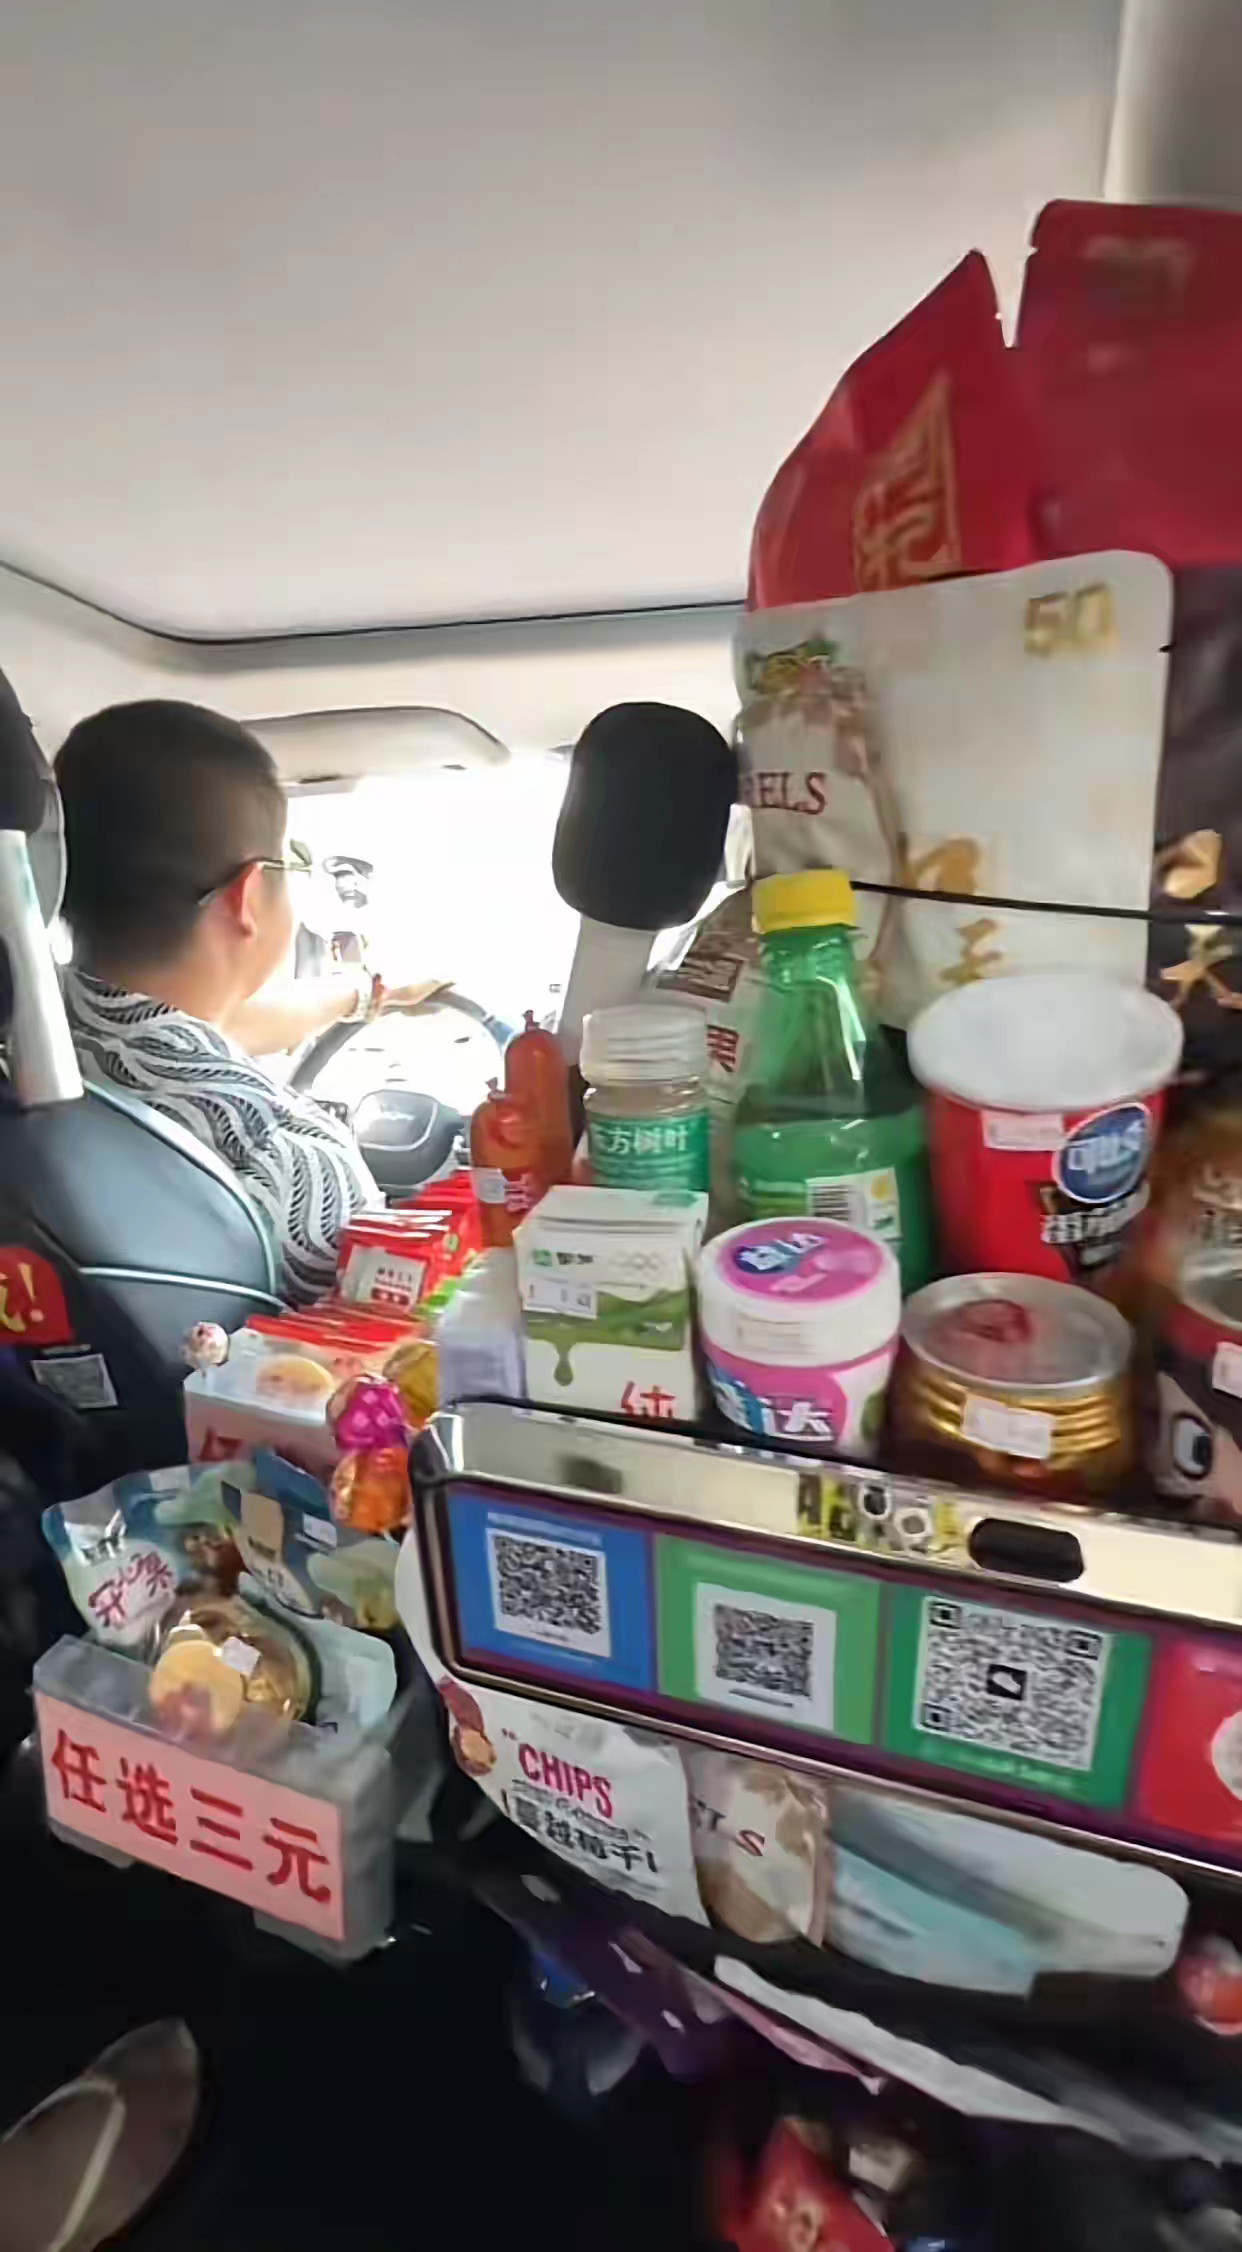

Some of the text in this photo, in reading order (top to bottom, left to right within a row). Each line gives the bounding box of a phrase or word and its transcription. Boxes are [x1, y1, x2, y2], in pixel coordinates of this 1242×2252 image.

[50, 1728, 332, 1904] 任选三元
[518, 1743, 613, 1819] CHIPS
